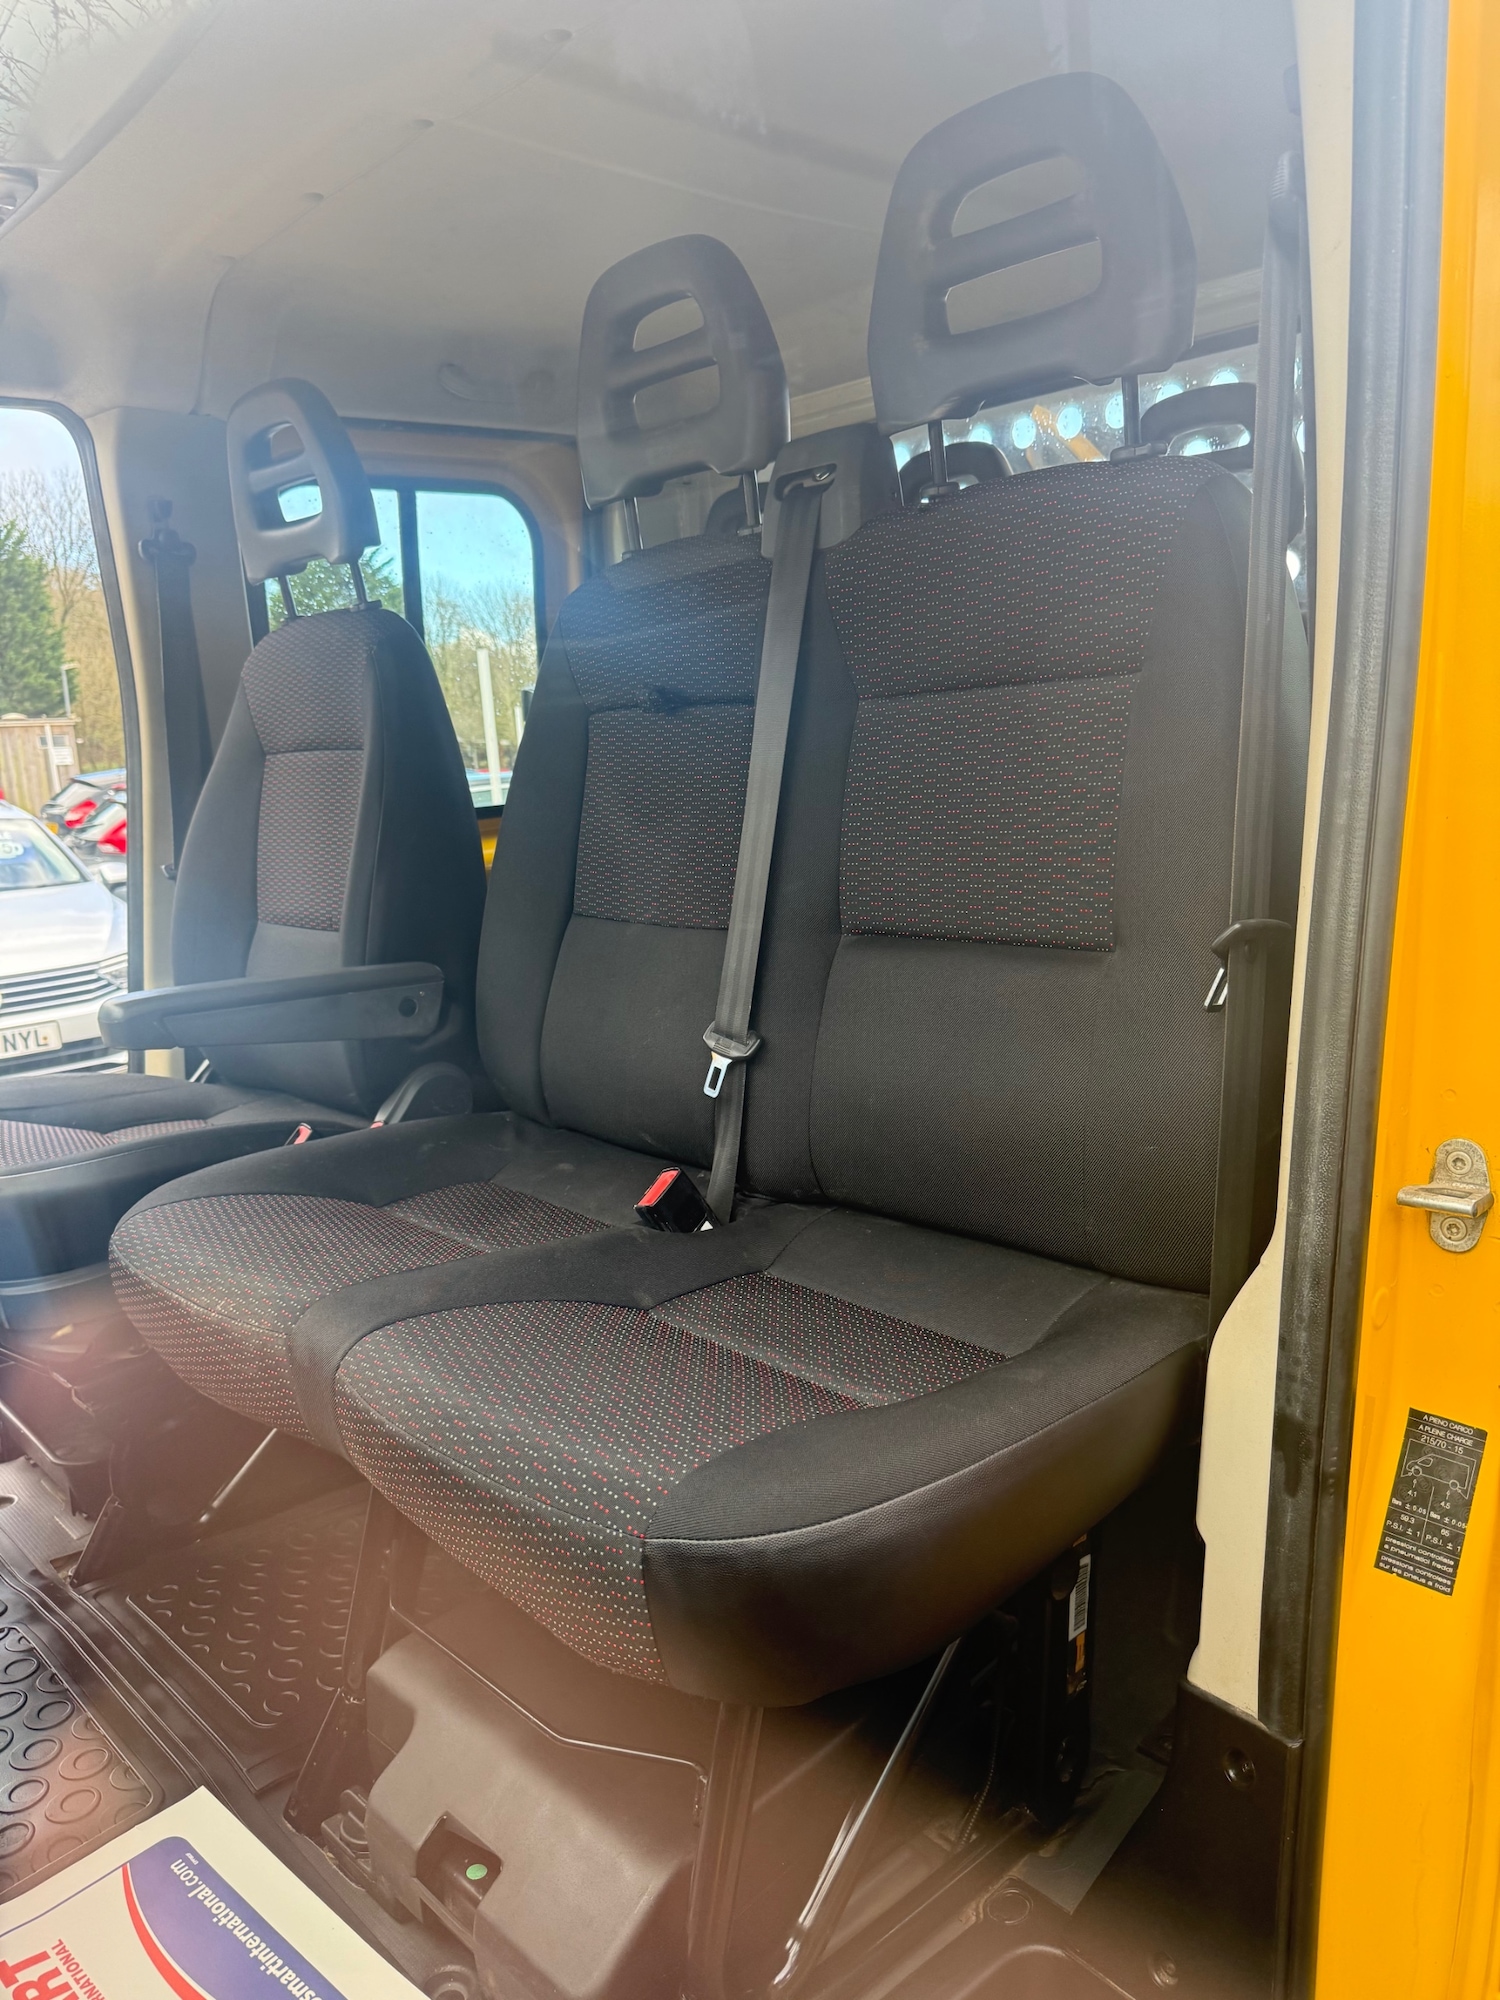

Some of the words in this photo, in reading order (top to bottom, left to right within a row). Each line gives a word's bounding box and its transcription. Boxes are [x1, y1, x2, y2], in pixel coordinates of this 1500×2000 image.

[3, 1030, 48, 1052] NYL
[1429, 1416, 1449, 1427] PIENO
[1449, 1422, 1474, 1435] CARICO
[1420, 1435, 1447, 1449] 215/70
[1454, 1446, 1464, 1455] 15
[1424, 1425, 1446, 1438] PLEINE
[1446, 1432, 1474, 1446] CHARGE
[1407, 1489, 1417, 1497] 4.1
[1440, 1501, 1451, 1509] 4.5
[1385, 1536, 1417, 1552] pressioni
[1403, 1571, 1426, 1584] pneus
[1435, 1582, 1451, 1593] froid
